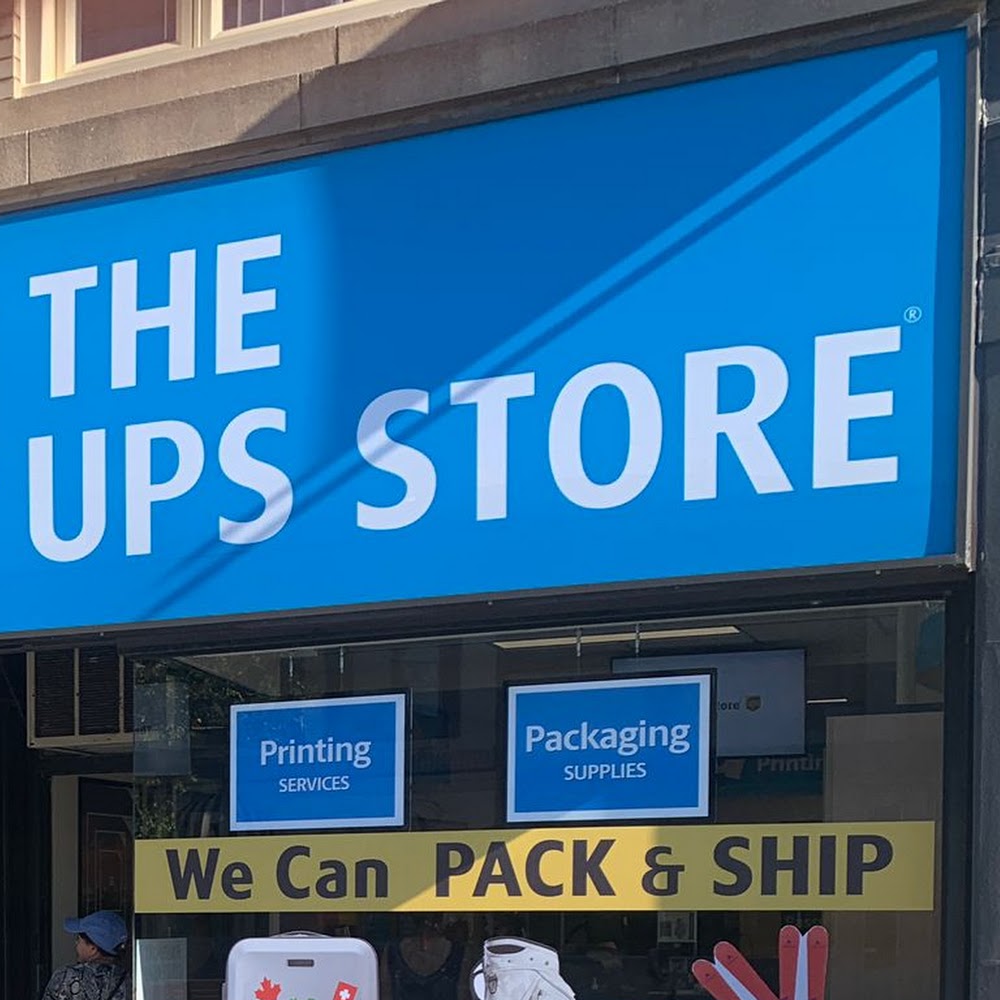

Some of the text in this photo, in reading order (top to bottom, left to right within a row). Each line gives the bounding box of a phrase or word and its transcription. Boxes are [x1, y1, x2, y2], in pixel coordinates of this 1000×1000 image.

[28, 233, 282, 399] THE
[28, 325, 901, 563] UPS STORE
[260, 736, 372, 769] Printing
[525, 718, 691, 755] Packaging
[279, 774, 350, 793] SERVICES
[563, 762, 647, 781] SUPPLIES
[165, 834, 895, 902] We Can PACK & SHIP
